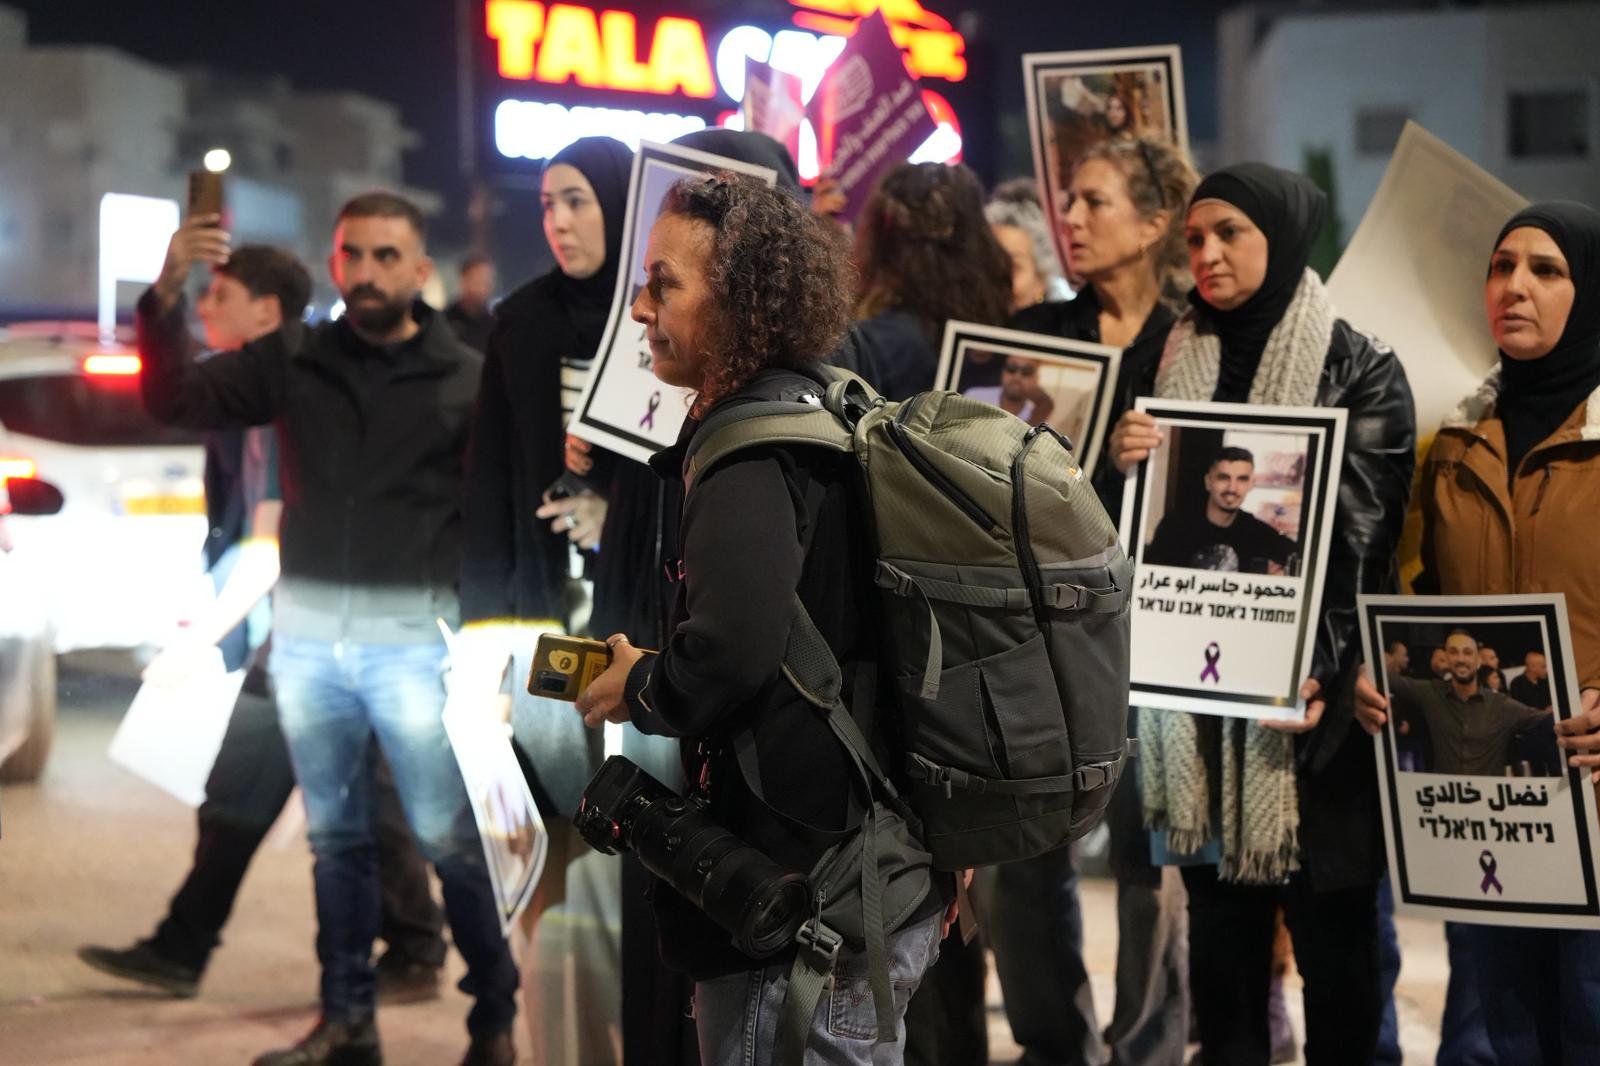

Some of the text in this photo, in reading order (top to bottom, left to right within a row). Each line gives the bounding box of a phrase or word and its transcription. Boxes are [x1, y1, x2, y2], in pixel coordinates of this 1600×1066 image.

[486, 0, 716, 98] TALA
[1243, 584, 1296, 600] محمود
[1138, 597, 1175, 613] עראר
[1179, 601, 1203, 615] אבו
[1251, 608, 1297, 624] מחמוד
[1416, 781, 1549, 813] نضال خالدي
[1490, 815, 1555, 843] נידאל
